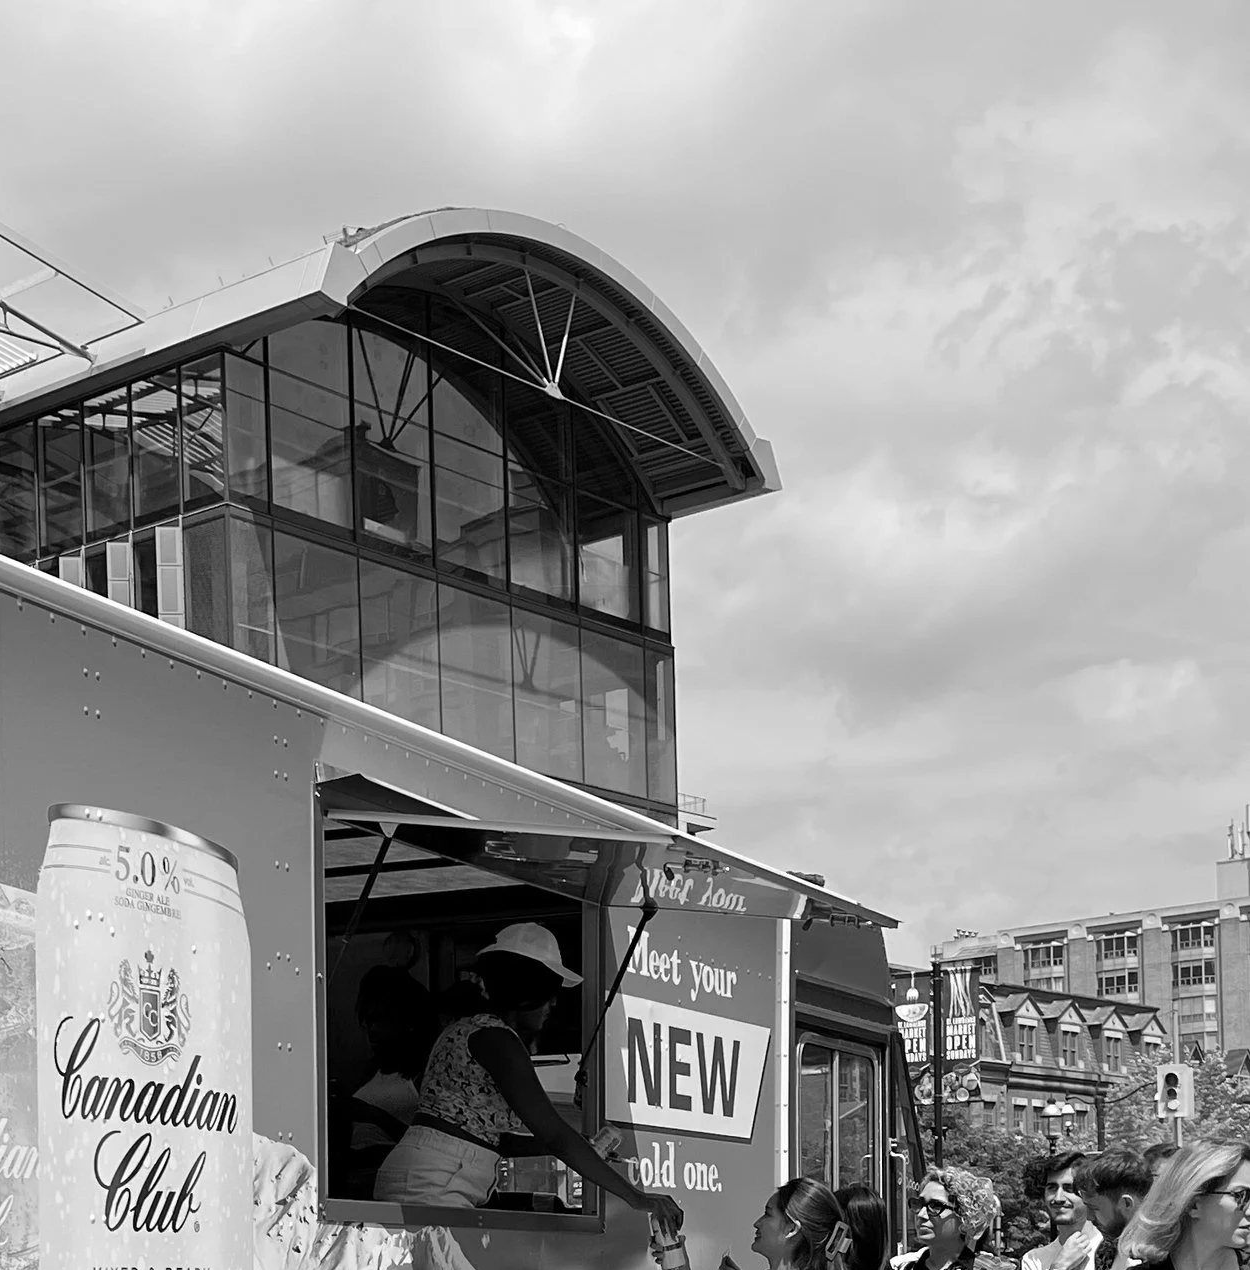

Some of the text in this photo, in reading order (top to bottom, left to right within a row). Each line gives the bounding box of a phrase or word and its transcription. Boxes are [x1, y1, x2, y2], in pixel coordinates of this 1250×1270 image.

[125, 887, 171, 906] GINGER ALE
[626, 925, 738, 1002] Meet your
[946, 1023, 976, 1036] MARKET
[904, 1038, 926, 1053] PEN
[946, 1035, 976, 1050] OPEN
[139, 1048, 163, 1063] 1858
[946, 1049, 976, 1060] SUNDAYS
[54, 1016, 238, 1134] Canadian
[627, 1016, 741, 1118] NEW
[627, 1141, 677, 1188] cold
